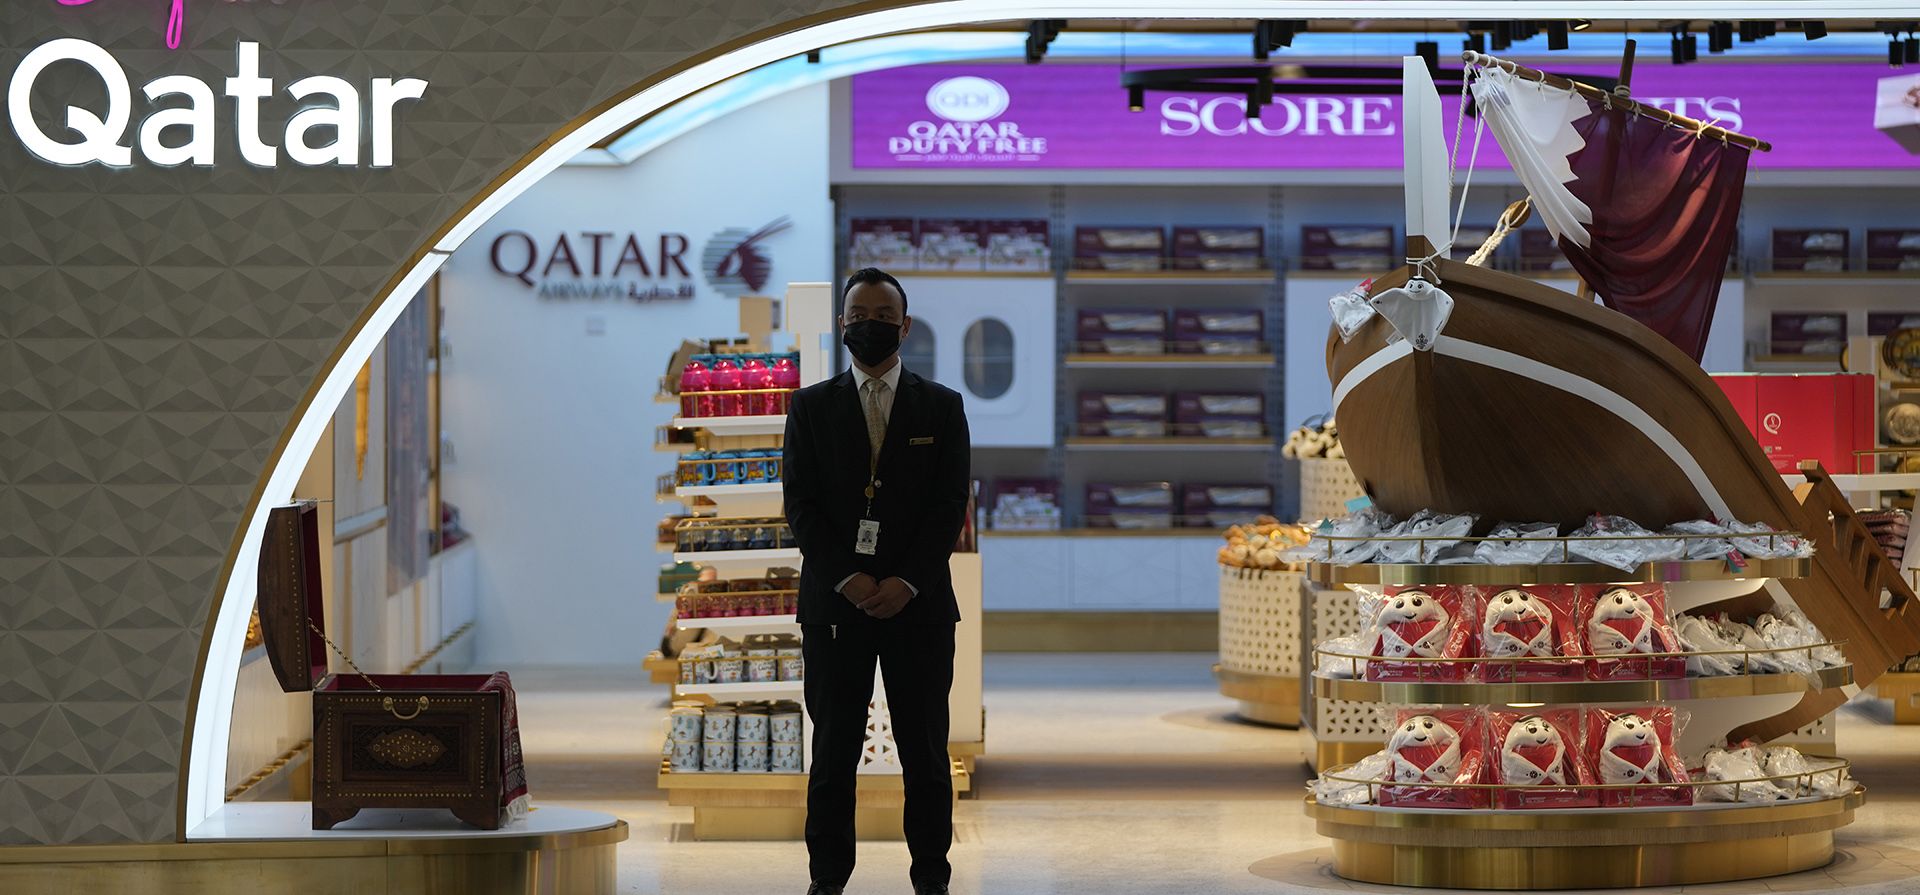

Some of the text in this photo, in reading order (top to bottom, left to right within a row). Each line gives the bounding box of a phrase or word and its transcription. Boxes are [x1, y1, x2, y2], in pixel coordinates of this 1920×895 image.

[8, 38, 429, 168] Qatar
[1160, 97, 1395, 136] SCORE
[907, 120, 1024, 140] QATAR
[888, 136, 1048, 154] DUTY FREE
[489, 229, 692, 287] QATAR
[538, 282, 624, 300] AIRWAYS
